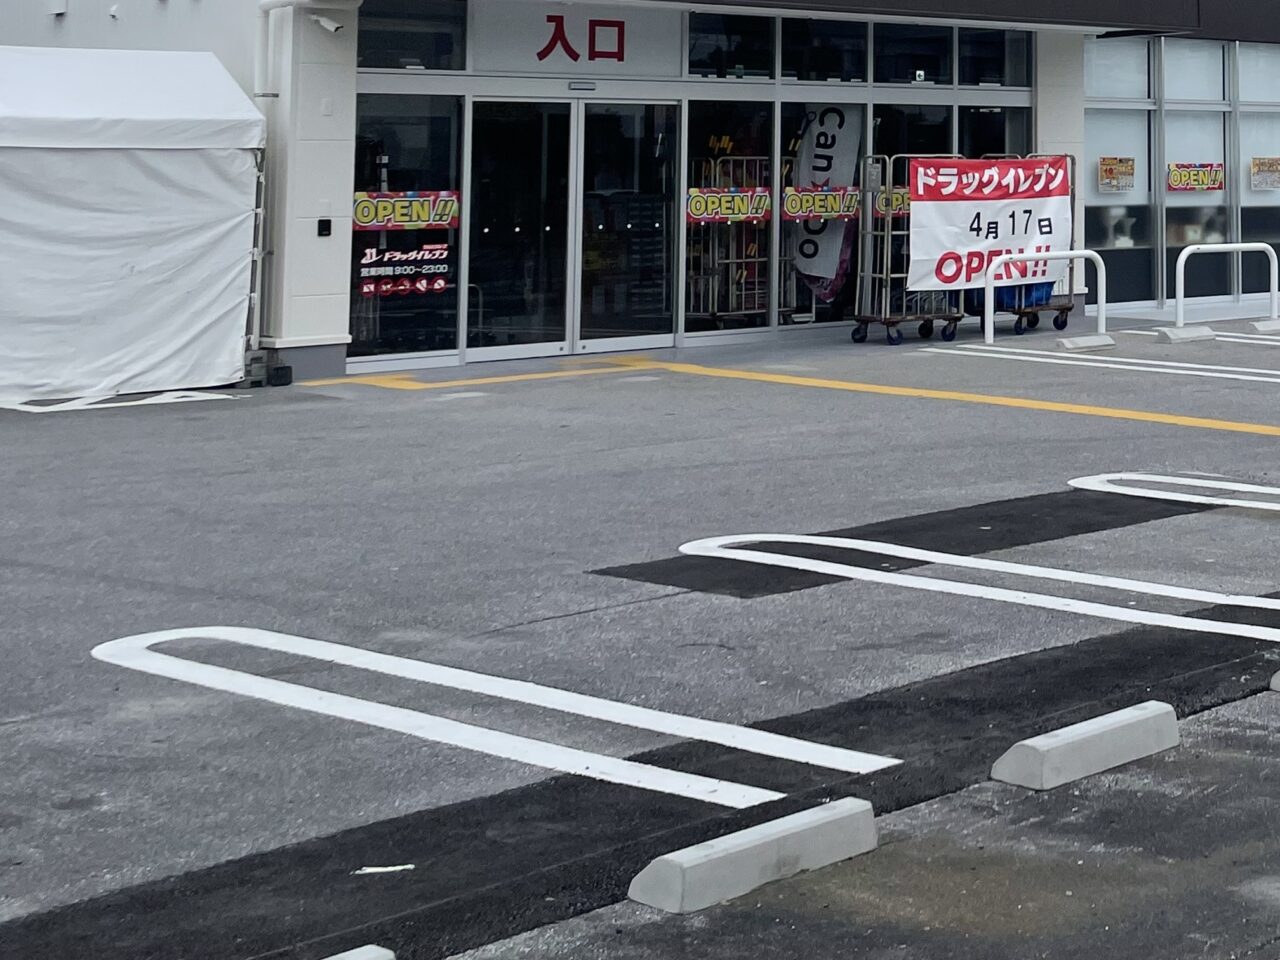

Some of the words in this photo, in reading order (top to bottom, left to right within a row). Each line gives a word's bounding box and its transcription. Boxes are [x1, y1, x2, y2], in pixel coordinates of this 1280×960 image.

[536, 14, 626, 63] 入口
[916, 164, 1064, 195] ドラッグイレブン
